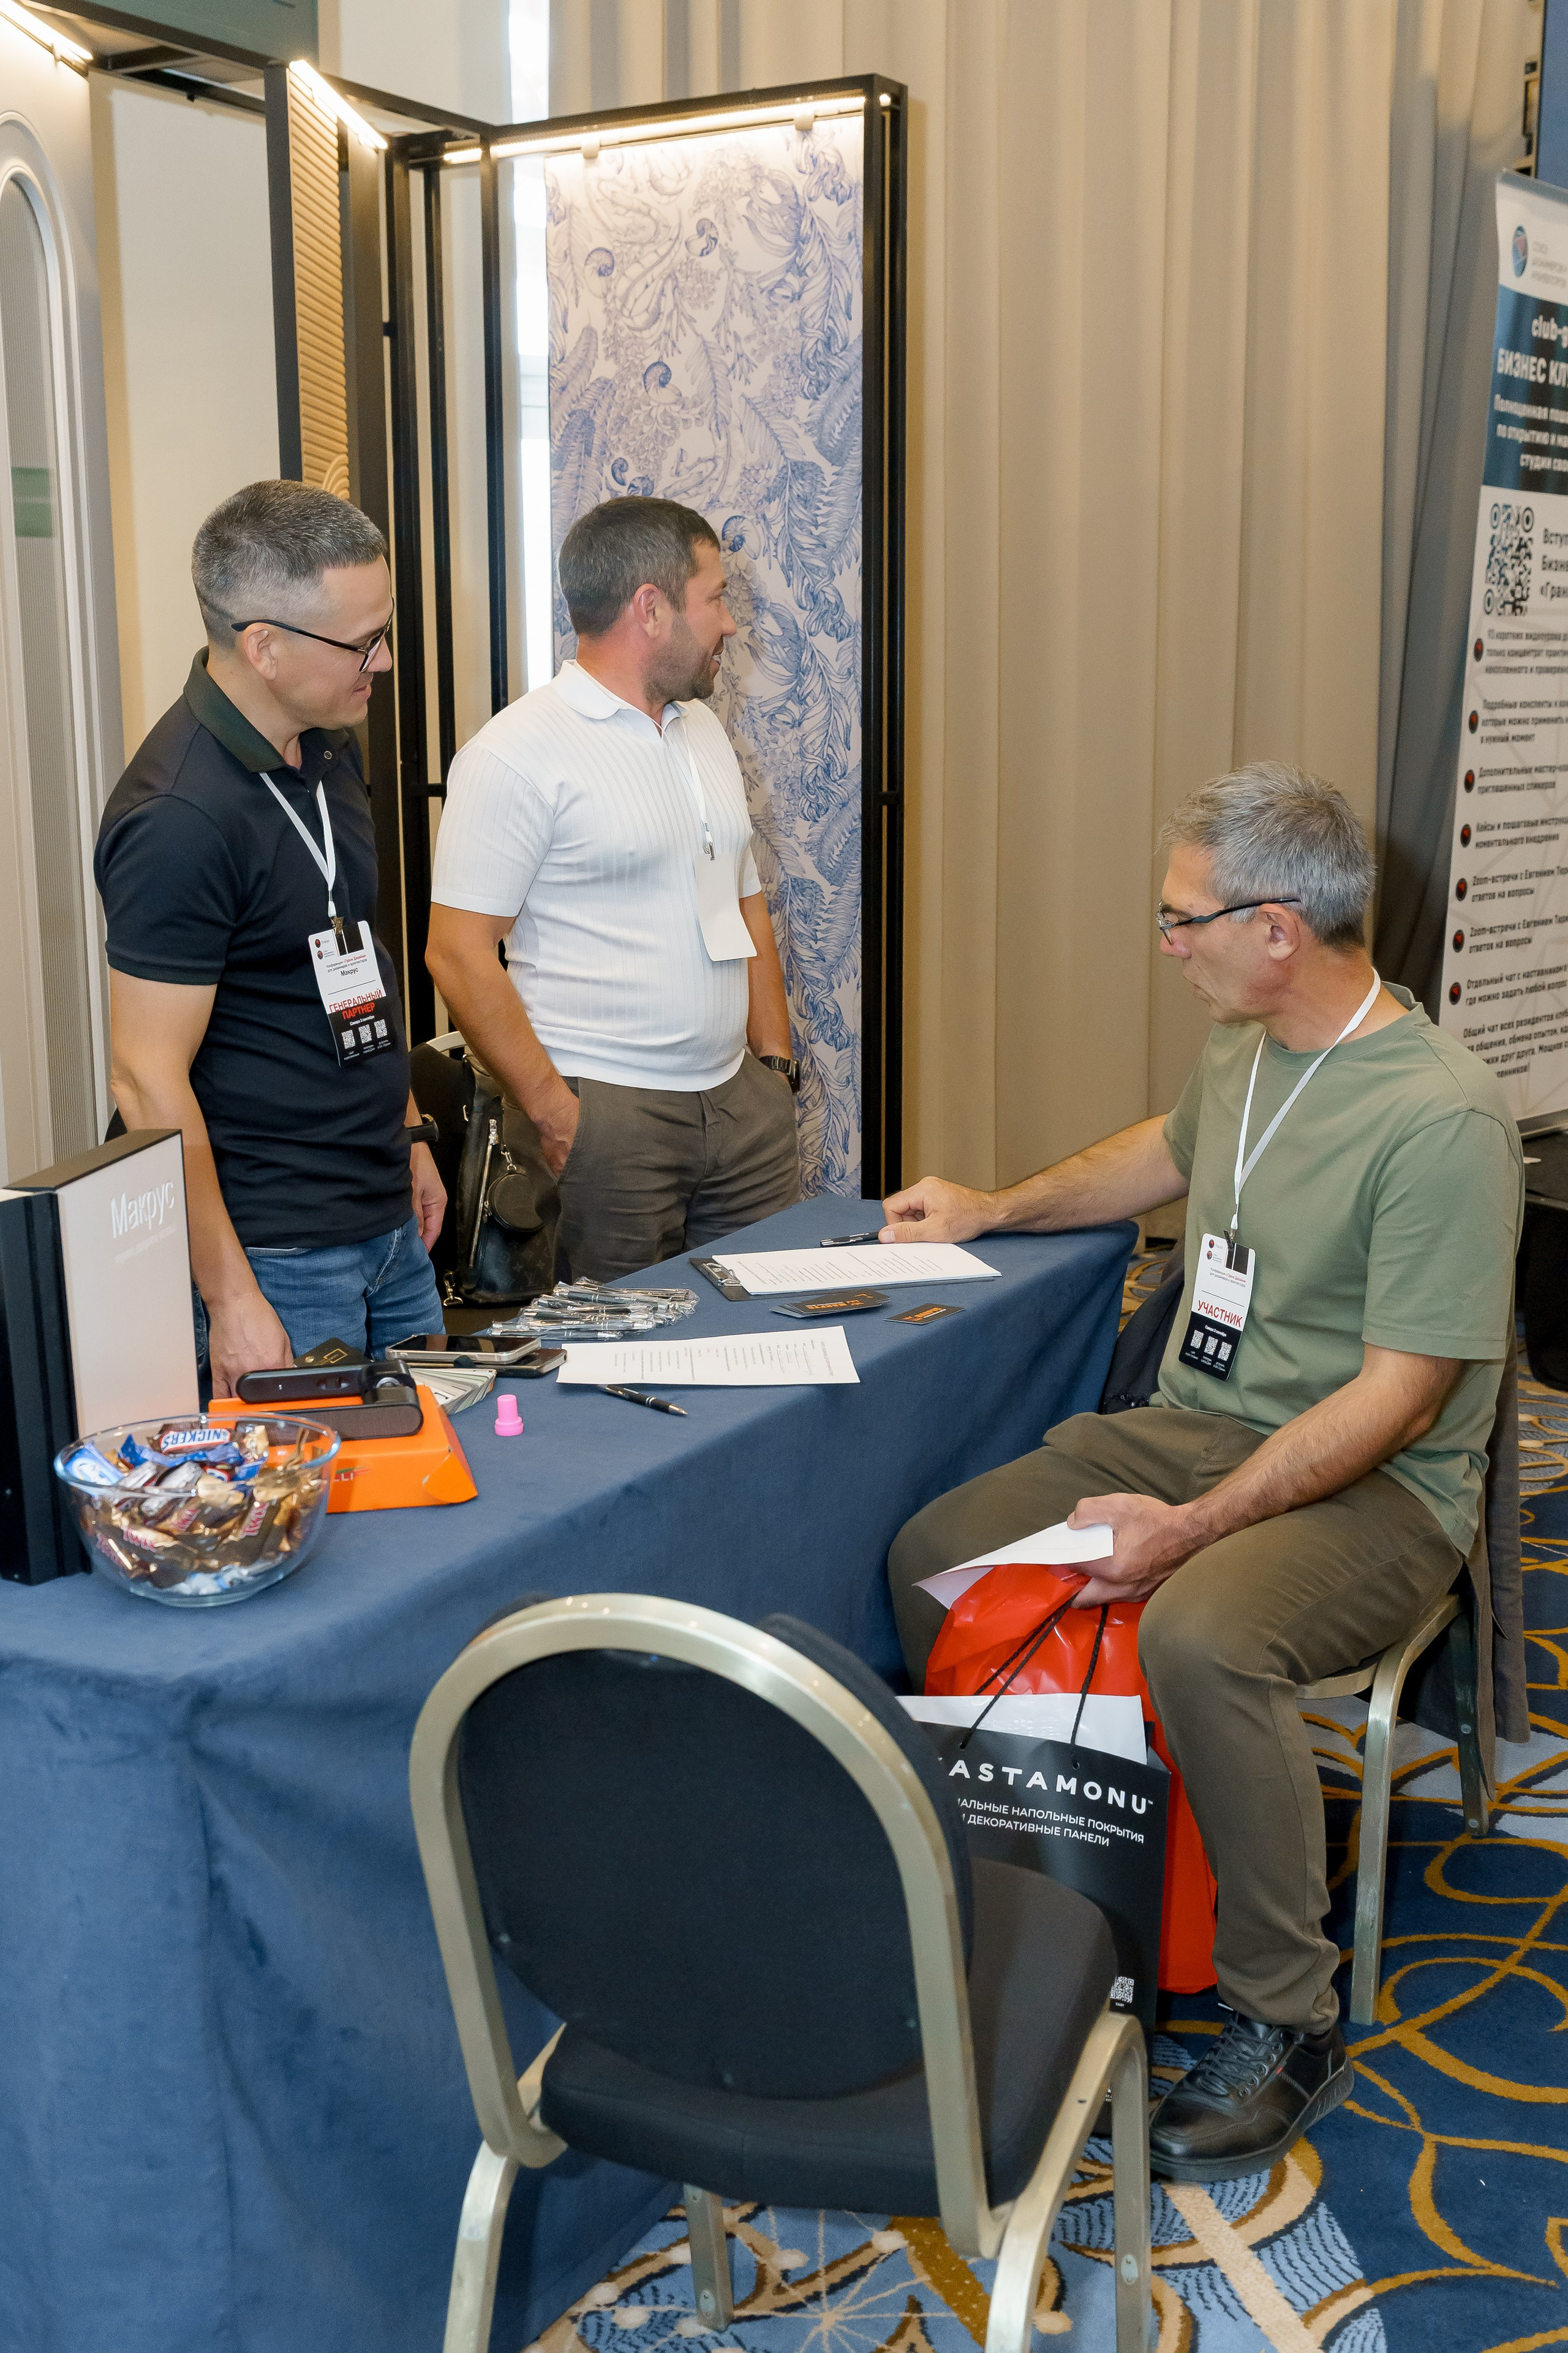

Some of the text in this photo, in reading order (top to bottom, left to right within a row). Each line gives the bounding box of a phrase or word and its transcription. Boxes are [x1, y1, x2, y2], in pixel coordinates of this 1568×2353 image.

[1497, 348, 1547, 383] БИЗНЕС
[341, 967, 359, 976] Макрус
[1466, 973, 1503, 989] Отдельный
[329, 988, 383, 1013] ГЕНЕРАЛЬНЫЙ
[1466, 997, 1476, 1006] где
[1478, 992, 1499, 1002] можно
[1502, 989, 1523, 999] задать
[1525, 982, 1545, 994] любой
[342, 1002, 375, 1019] ПАРТНЕР
[1463, 1024, 1485, 1038] Общий
[1501, 1021, 1514, 1030] всех
[1516, 1014, 1553, 1029] резидентов
[1509, 1033, 1532, 1045] обмена
[1501, 1052, 1515, 1063] друг
[110, 1180, 175, 1240] Макрус
[1197, 1300, 1243, 1328] УЧАСТНИК
[957, 1798, 1144, 1844] АЛЬНЫЕ НАПОЛЬНЫЕ ПОКРЫТИЯ
[968, 1816, 1110, 1847] ДЕКОРАТИВНЫЕ ПАНЕЛИ
